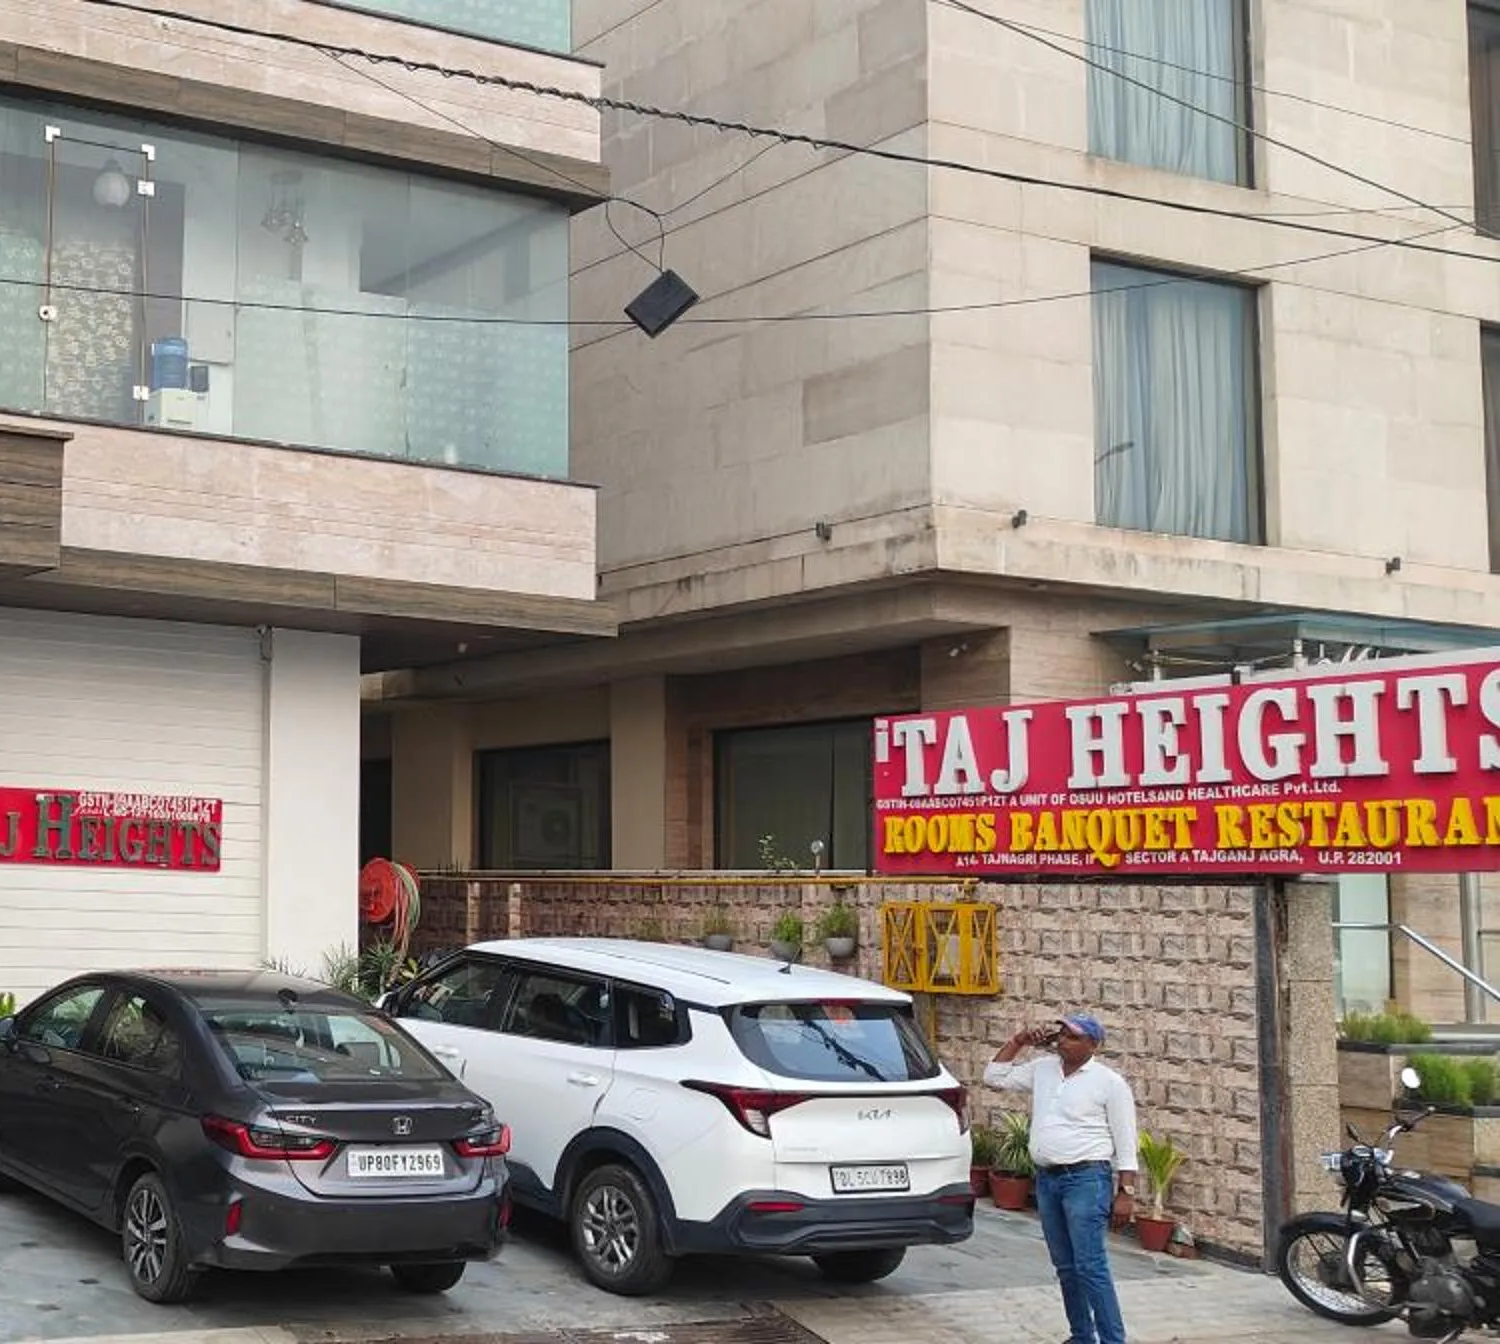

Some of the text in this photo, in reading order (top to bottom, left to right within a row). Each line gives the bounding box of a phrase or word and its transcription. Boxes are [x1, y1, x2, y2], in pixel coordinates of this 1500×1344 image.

[1020, 793, 1048, 806] UNIT
[1051, 792, 1066, 805] OF
[1188, 783, 1280, 800] HEALTHCARE
[884, 813, 997, 854] ROOMS
[1010, 806, 1197, 867] BANQUET
[983, 853, 1037, 865] TAJNAGRI
[1040, 853, 1083, 866] PHASE,
[1126, 851, 1176, 865] SECTOR
[1179, 851, 1189, 863] A
[1194, 850, 1255, 863] TAJGANJ
[1348, 852, 1401, 865] 282001
[285, 1114, 317, 1125] CITY
